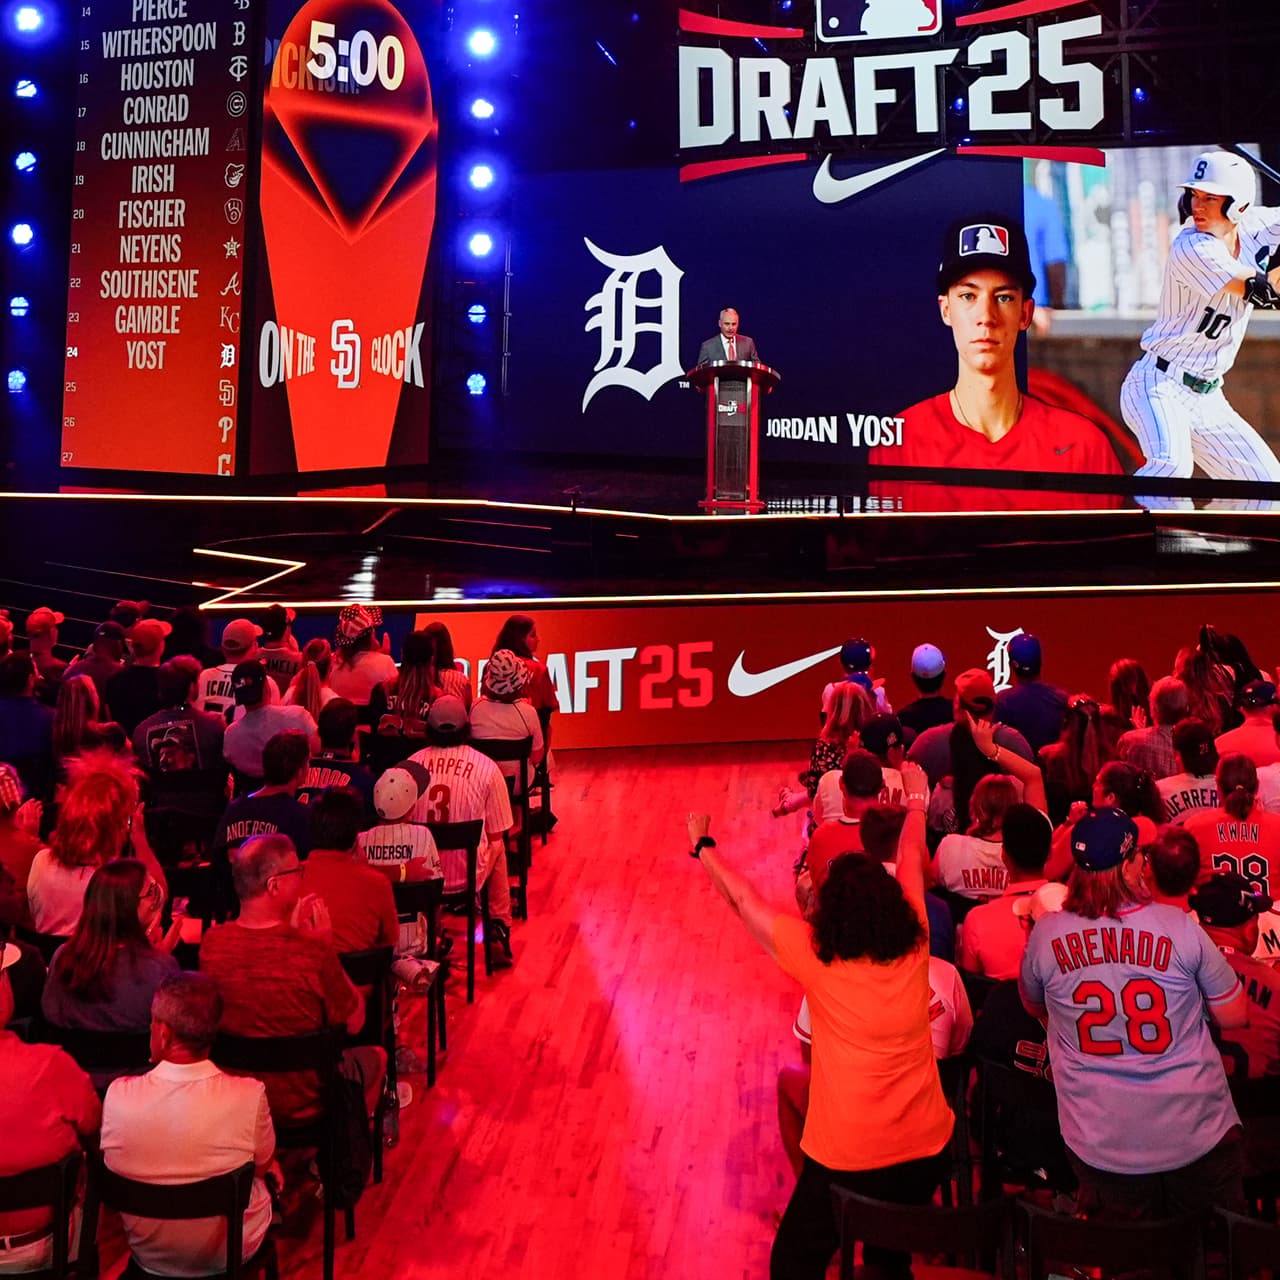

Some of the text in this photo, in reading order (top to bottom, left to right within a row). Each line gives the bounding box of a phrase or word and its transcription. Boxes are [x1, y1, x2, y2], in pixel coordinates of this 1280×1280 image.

[81, 6, 91, 17] 14
[80, 40, 90, 51] 15
[102, 22, 217, 59] WITHERSPOON
[306, 20, 405, 91] 5:00
[79, 73, 89, 84] 16
[120, 59, 194, 91] HOUSTON
[679, 14, 1105, 149] DRAFT 25
[77, 107, 86, 118] 17
[123, 94, 189, 125] CONRAD
[76, 141, 85, 151] 18
[101, 127, 210, 160] CUNNINGHAM
[74, 164, 175, 194] 19 IRISH
[1194, 160, 1208, 180] S
[73, 199, 186, 229] 20 FISCHER
[72, 243, 81, 254] 21
[119, 234, 182, 264] NEYENS
[70, 277, 81, 289] 22
[100, 269, 200, 299] SOUTHISENE
[69, 313, 80, 322] 23
[115, 305, 181, 334] GAMBLE
[1196, 305, 1231, 340] 10
[67, 347, 78, 358] 24
[126, 340, 167, 369] YOST
[259, 320, 292, 388] ON
[296, 332, 315, 377] THE
[371, 321, 424, 388] CLOCK
[65, 382, 77, 392] 25
[64, 417, 75, 427] 26
[766, 412, 905, 447] JORDAN YOST
[62, 452, 73, 462] 27
[639, 641, 713, 710] 25
[422, 758, 473, 779] ARPER
[427, 784, 450, 823] 3
[1166, 788, 1219, 820] UERRER
[1217, 823, 1259, 843] KWAN
[363, 845, 414, 861] NDERSON
[1052, 927, 1172, 974] ARENADO
[1072, 977, 1173, 1057] 28
